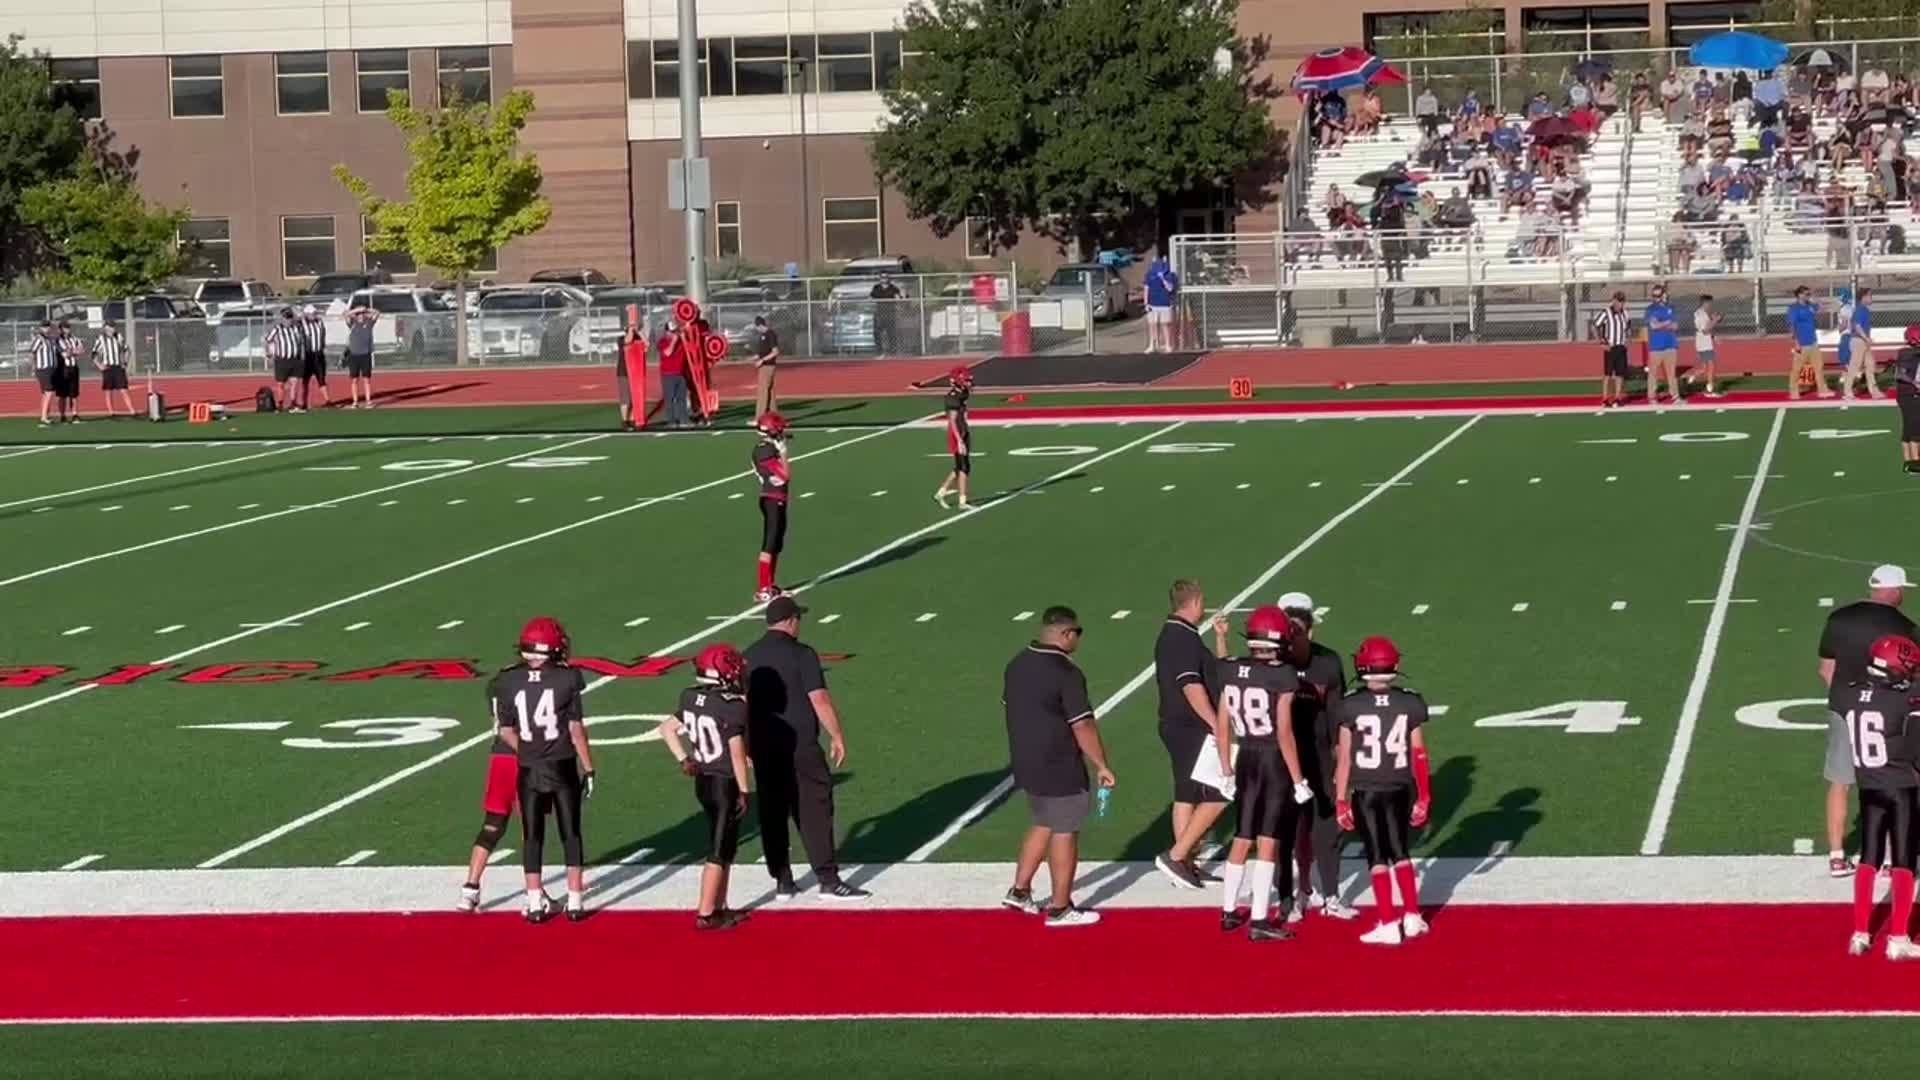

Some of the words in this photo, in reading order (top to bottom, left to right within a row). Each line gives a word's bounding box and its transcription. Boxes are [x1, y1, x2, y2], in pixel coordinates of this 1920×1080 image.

[1232, 379, 1250, 397] 30
[193, 404, 207, 420] 10
[528, 670, 541, 682] H
[1238, 666, 1251, 678] H
[1374, 694, 1390, 706] H
[1859, 690, 1873, 702] H
[514, 688, 559, 741] 14
[1355, 713, 1408, 769] 34
[1846, 708, 1888, 768] 16
